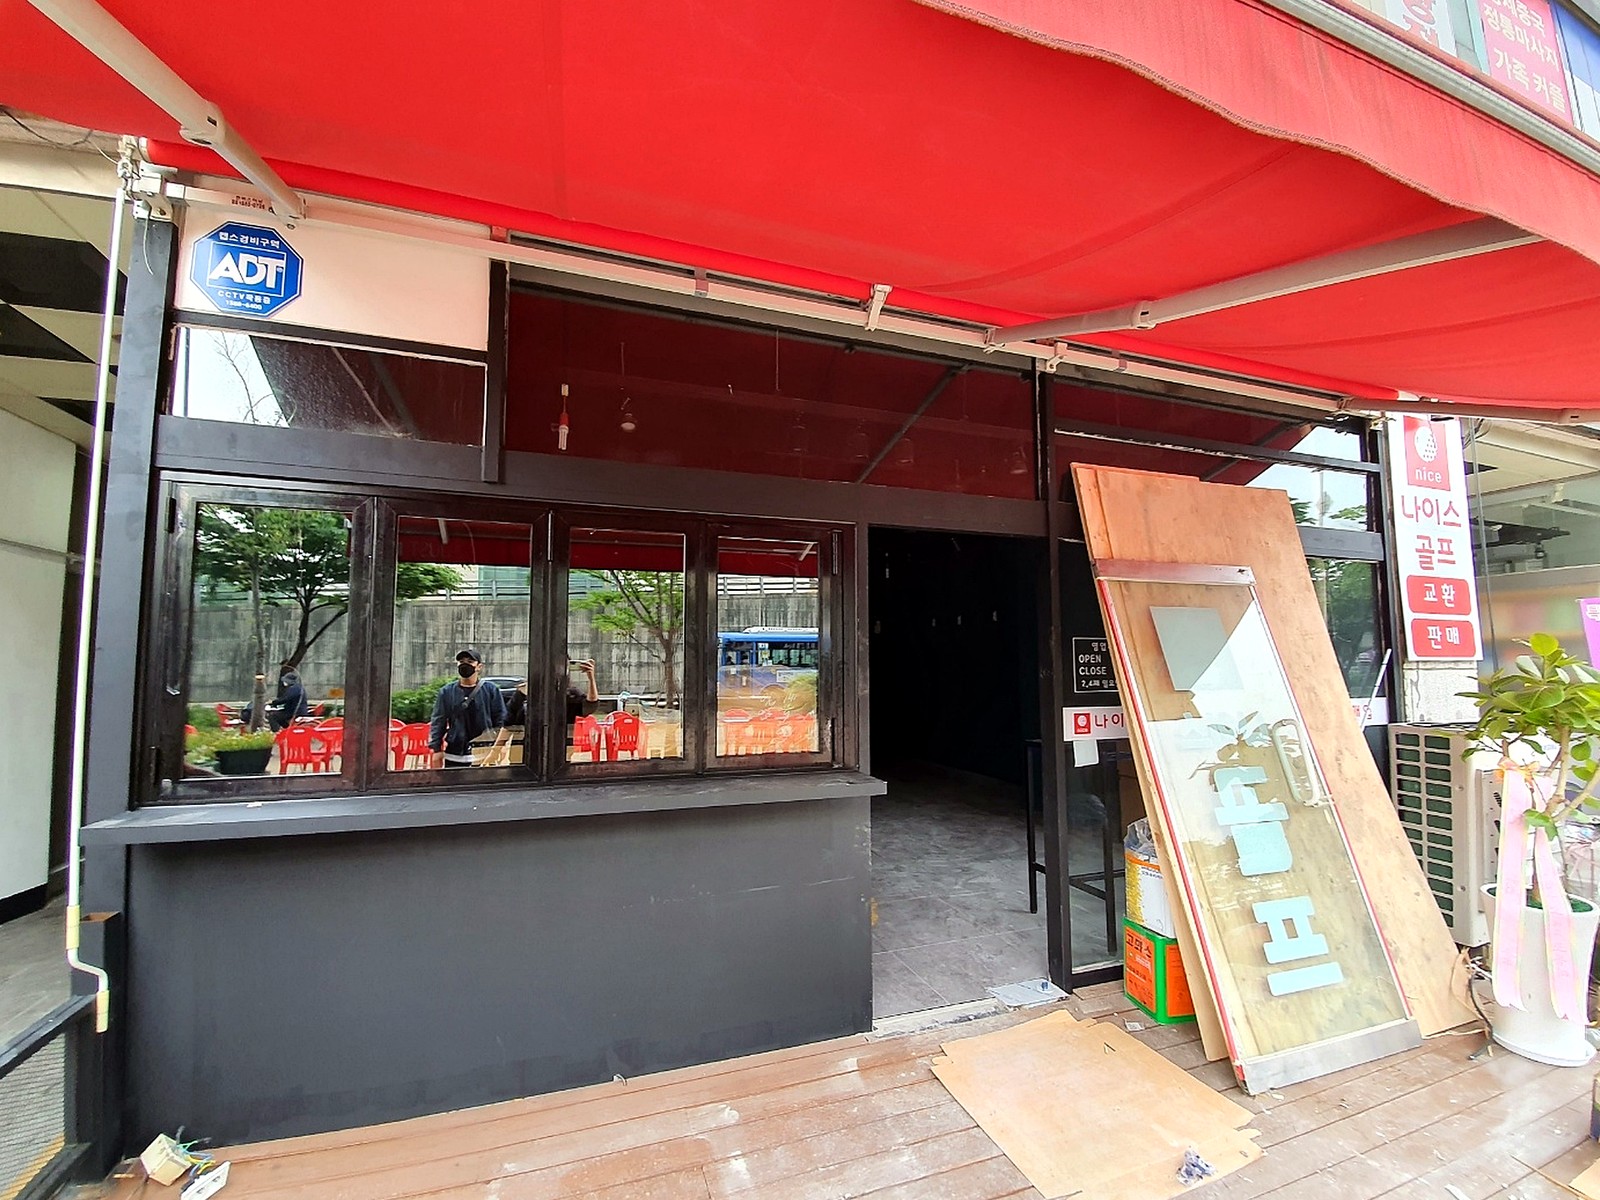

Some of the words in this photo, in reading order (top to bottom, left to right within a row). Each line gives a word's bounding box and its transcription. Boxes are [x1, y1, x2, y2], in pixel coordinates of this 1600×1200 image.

[1483, 3, 1560, 72] 정통마사지
[1494, 47, 1529, 91] 가족
[1532, 72, 1566, 114] 커플
[208, 252, 285, 288] ADT
[1415, 467, 1442, 483] nice
[1401, 495, 1462, 528] 나이스
[1415, 535, 1456, 571] 골프
[1423, 583, 1456, 608] 교환
[1426, 625, 1460, 650] 판매
[1078, 654, 1102, 663] OPEN
[1078, 666, 1107, 675] CLOSE
